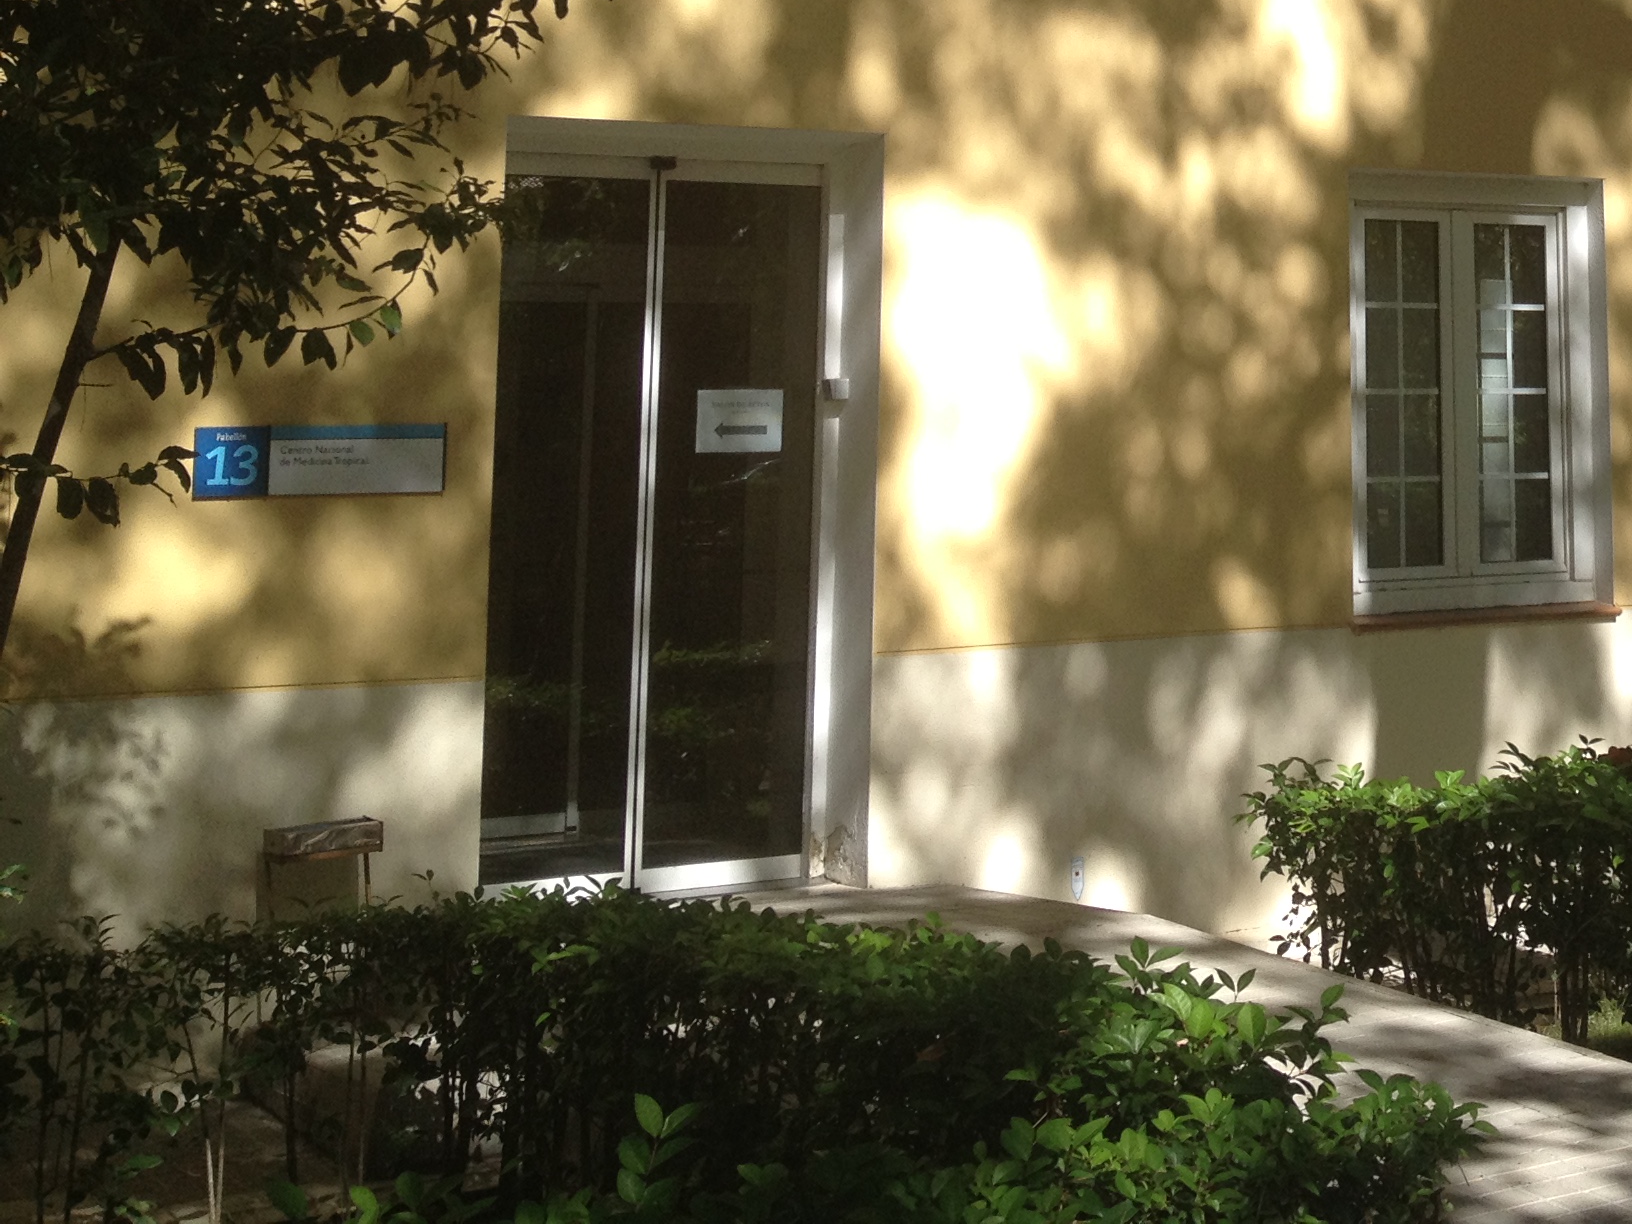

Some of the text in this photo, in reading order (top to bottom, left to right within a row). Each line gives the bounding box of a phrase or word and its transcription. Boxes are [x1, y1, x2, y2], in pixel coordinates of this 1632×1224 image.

[216, 432, 247, 441] Pabellón
[280, 444, 354, 455] Centro Nacional
[205, 444, 259, 486] 13
[279, 455, 370, 467] de Medicina Tropical
